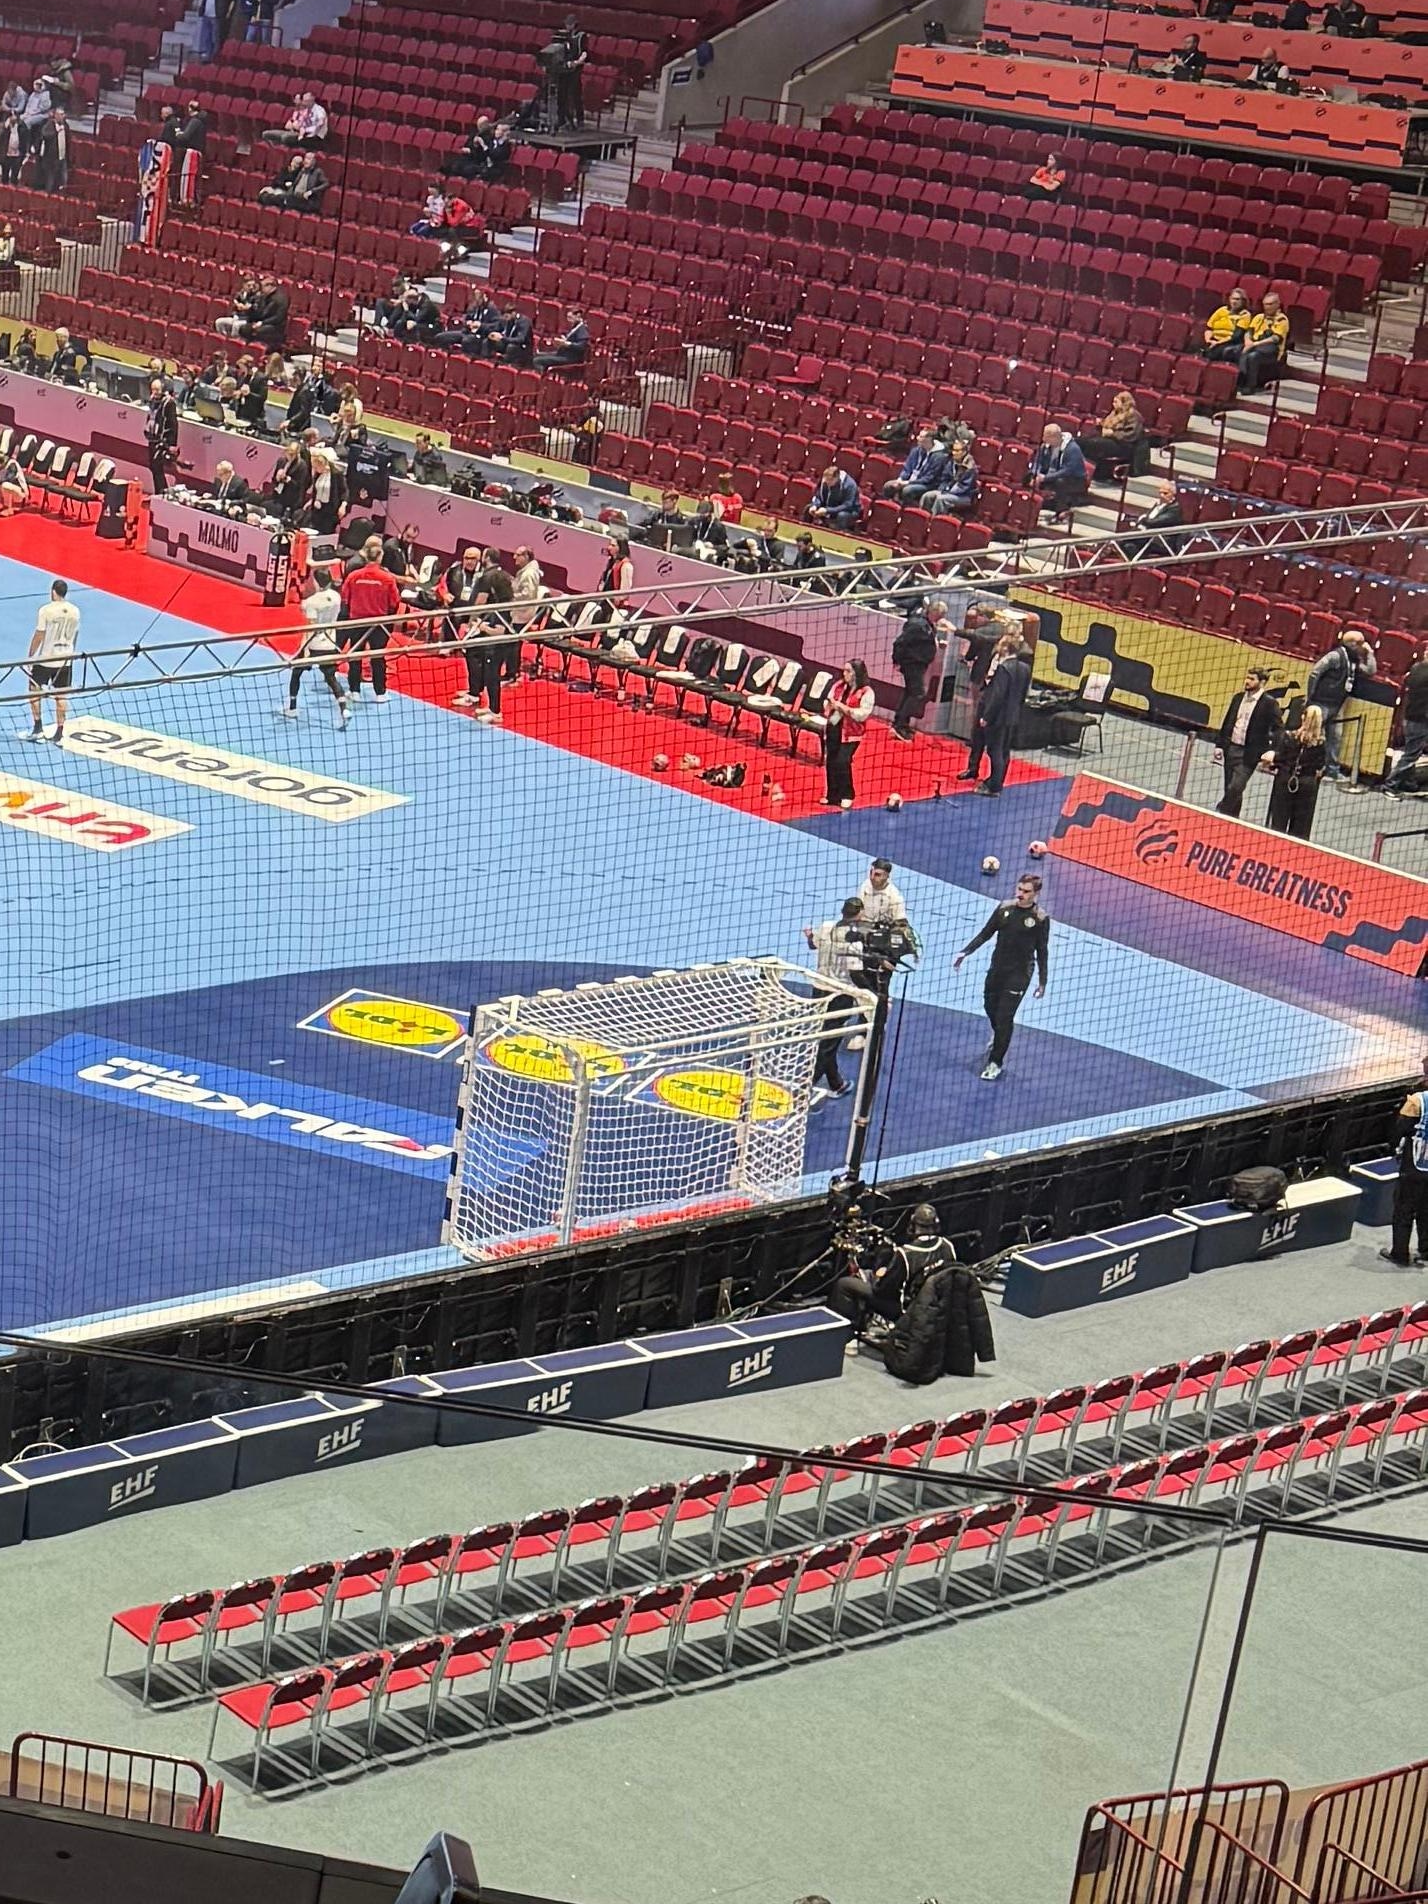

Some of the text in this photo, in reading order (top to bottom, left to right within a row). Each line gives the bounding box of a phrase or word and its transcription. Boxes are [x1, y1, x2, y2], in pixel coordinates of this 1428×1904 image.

[198, 520, 240, 554] MALMÖ
[68, 728, 369, 809] gorenje
[1184, 840, 1353, 920] PURE GREATNESS
[1101, 1252, 1138, 1288] EHF
[729, 1345, 775, 1383] EHF
[527, 1380, 573, 1413] EHF
[317, 1417, 365, 1457] EHF
[110, 1464, 160, 1505] EHF
